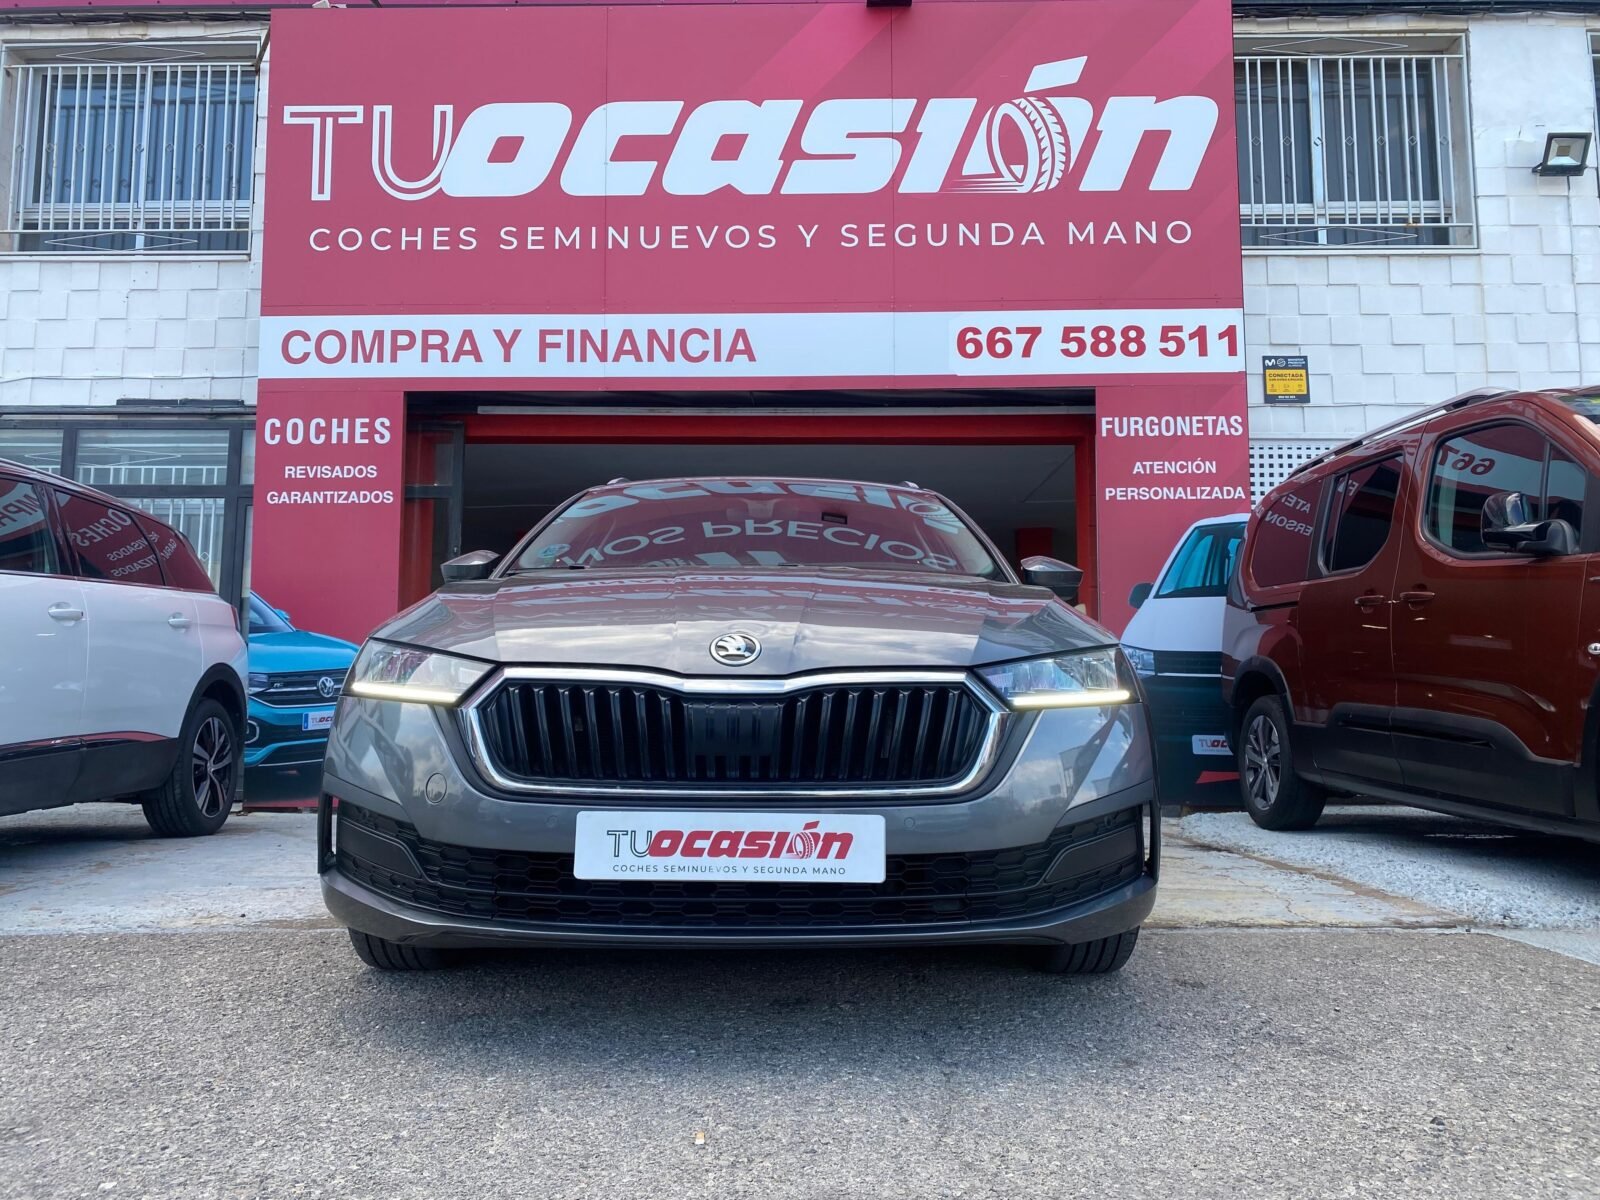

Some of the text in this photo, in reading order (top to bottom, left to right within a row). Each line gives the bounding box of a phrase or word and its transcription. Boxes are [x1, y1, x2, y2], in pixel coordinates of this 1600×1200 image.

[309, 220, 1192, 251] COCHES SEMINUEVOS Y SEGUNDA MANO
[281, 327, 757, 365] COMPRA Y FINANCIA
[956, 324, 1238, 360] 667 588 511
[264, 417, 391, 445] COCHES
[1101, 415, 1244, 437] FURGONETAS
[284, 465, 378, 479] REVISADOS
[1132, 457, 1217, 474] ATENCIÓN
[266, 490, 394, 504] GARANTIZADOS
[1105, 486, 1246, 501] PERSONALIZADA
[612, 864, 846, 875] COCHES SEMINUEVOS Y SEGUNDA MANO
